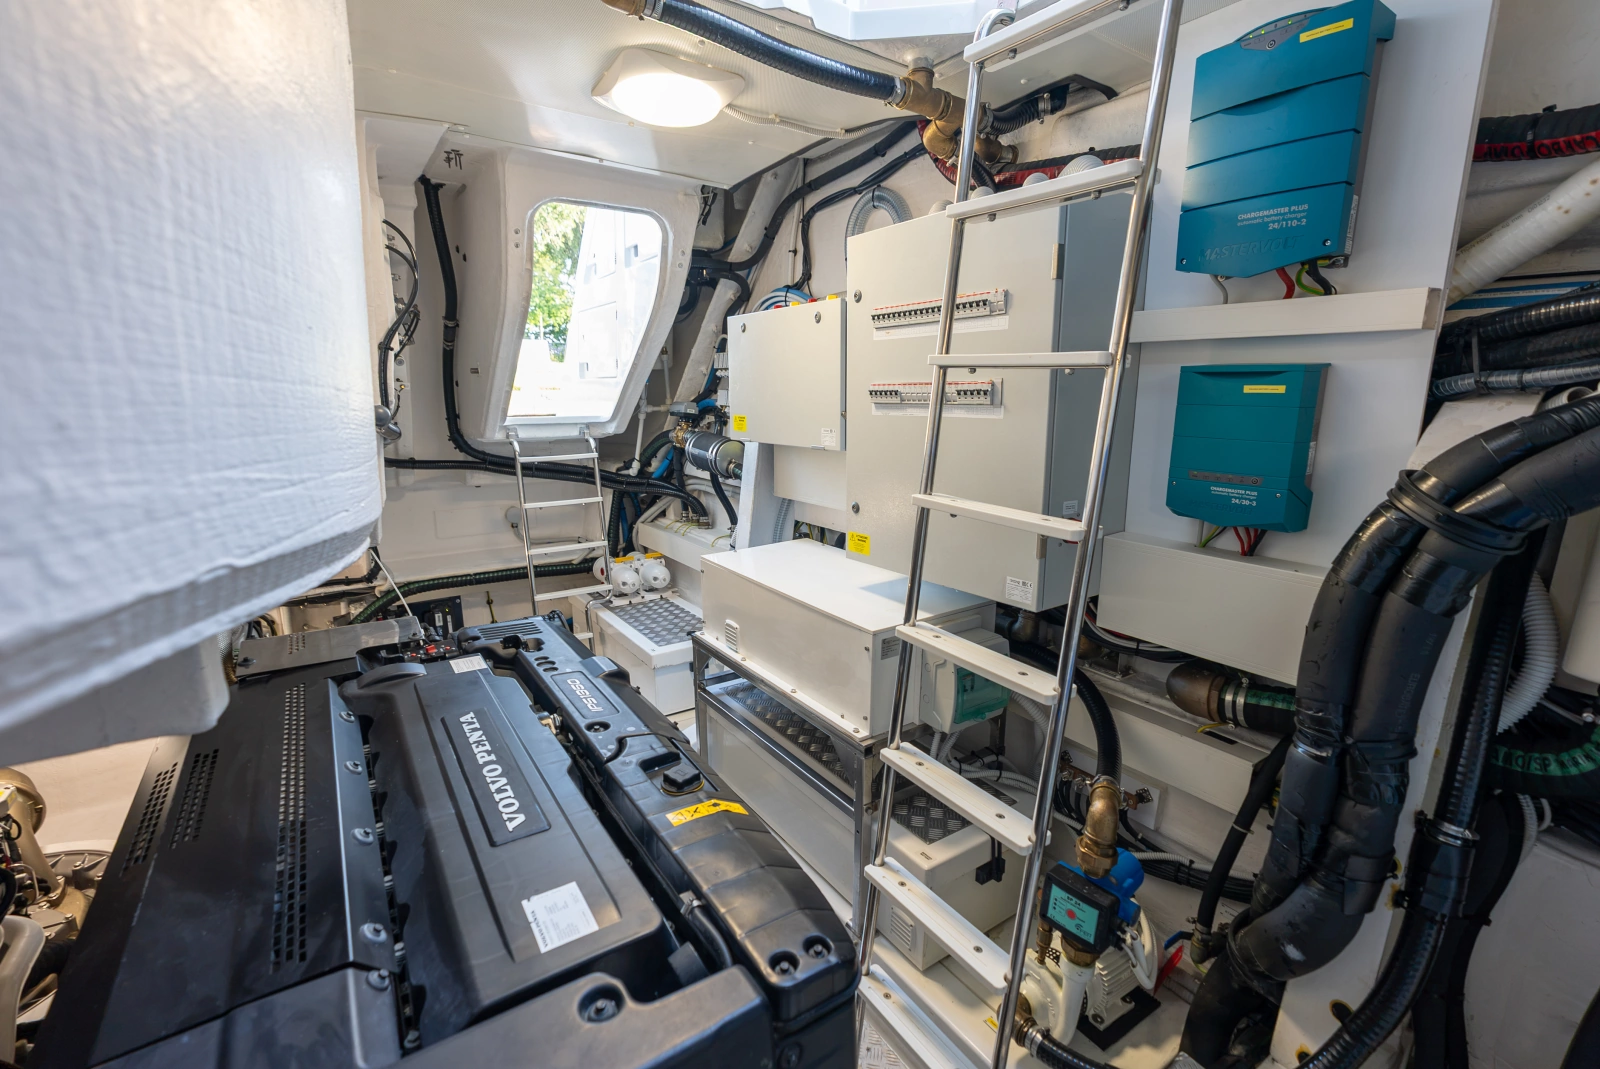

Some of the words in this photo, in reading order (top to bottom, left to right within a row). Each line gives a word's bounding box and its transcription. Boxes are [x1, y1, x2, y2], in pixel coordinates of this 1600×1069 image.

[1237, 206, 1289, 220] CHARGEMASTER
[1237, 218, 1263, 226] automatic
[1268, 218, 1306, 230] 24/110-2
[1198, 234, 1304, 262] MASTERVOLT
[1210, 486, 1246, 494] CHARGEMASTER
[1231, 498, 1257, 506] 24/30-3
[459, 711, 497, 765] PENTA
[482, 764, 527, 832] VOLVO
